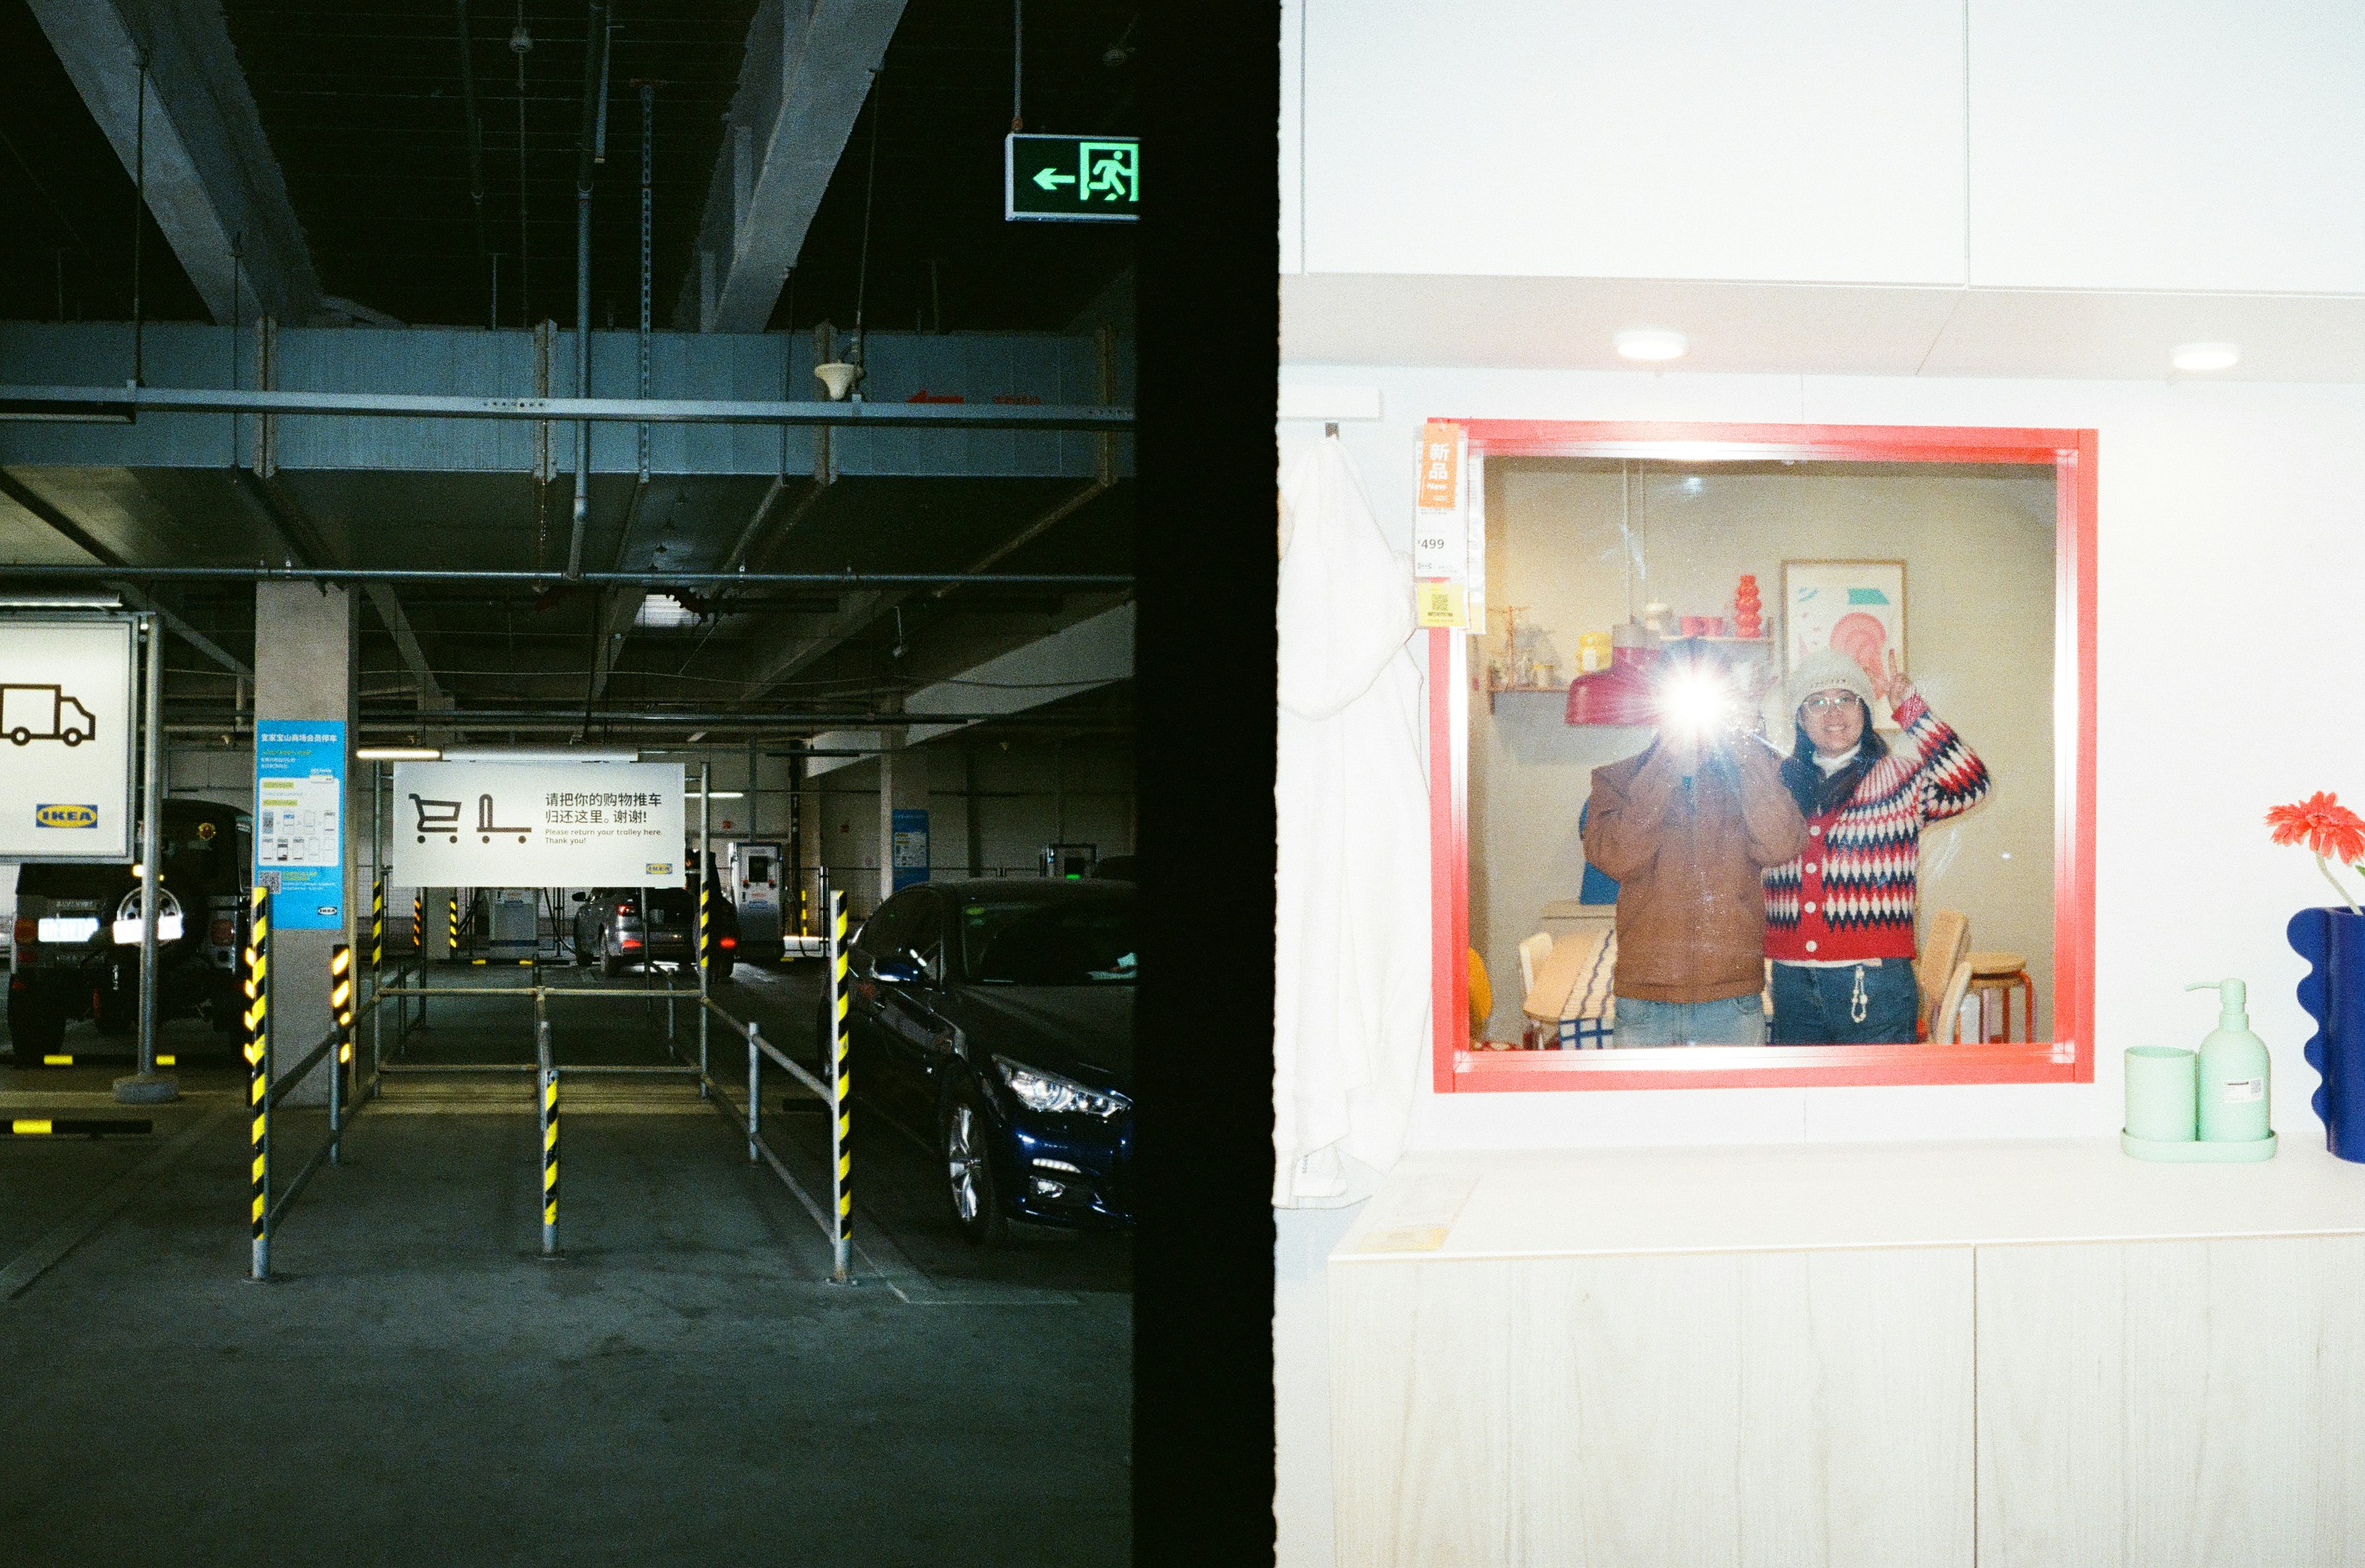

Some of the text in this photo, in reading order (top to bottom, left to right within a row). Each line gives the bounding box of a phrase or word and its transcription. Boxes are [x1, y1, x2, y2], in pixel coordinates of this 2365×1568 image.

[1430, 442, 1450, 480] 新品
[546, 792, 662, 807] 请把你的购物推车
[42, 811, 92, 821] IKEA
[617, 828, 641, 837] trolley
[570, 837, 586, 846] you!
